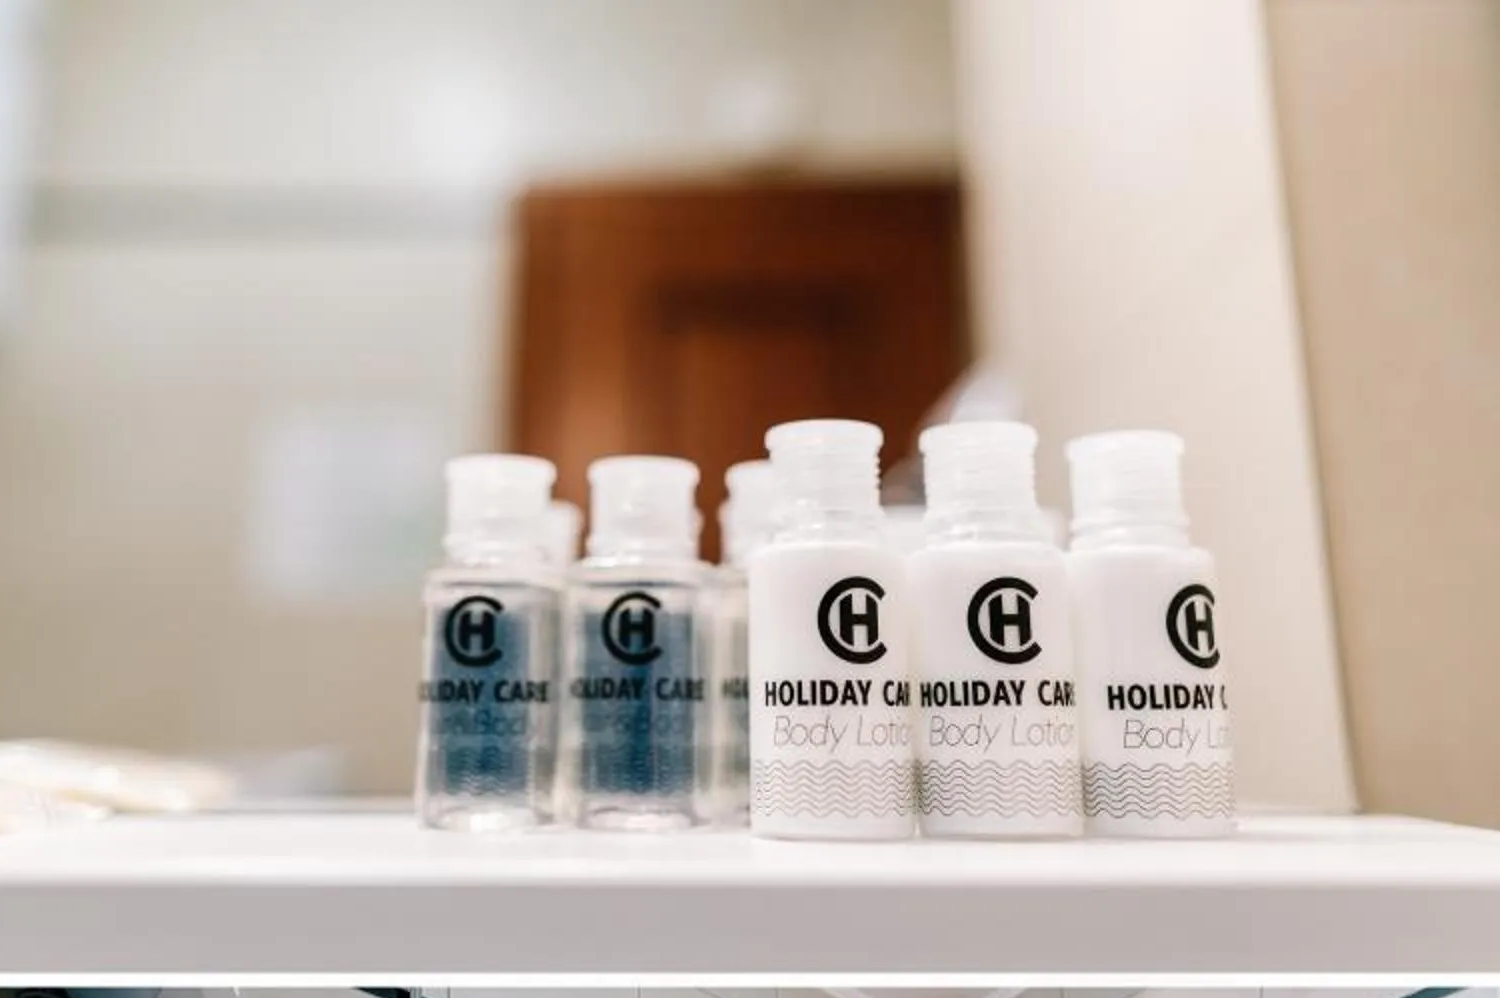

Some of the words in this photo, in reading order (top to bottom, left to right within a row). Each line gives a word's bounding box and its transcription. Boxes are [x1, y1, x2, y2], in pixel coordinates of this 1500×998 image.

[764, 679, 873, 707] HOLIDAY
[920, 679, 1026, 707] HOLIDAY
[1106, 683, 1214, 710] HOLIDAY
[773, 714, 849, 753] Body
[929, 713, 1000, 753] Body
[1122, 716, 1201, 757] Body
